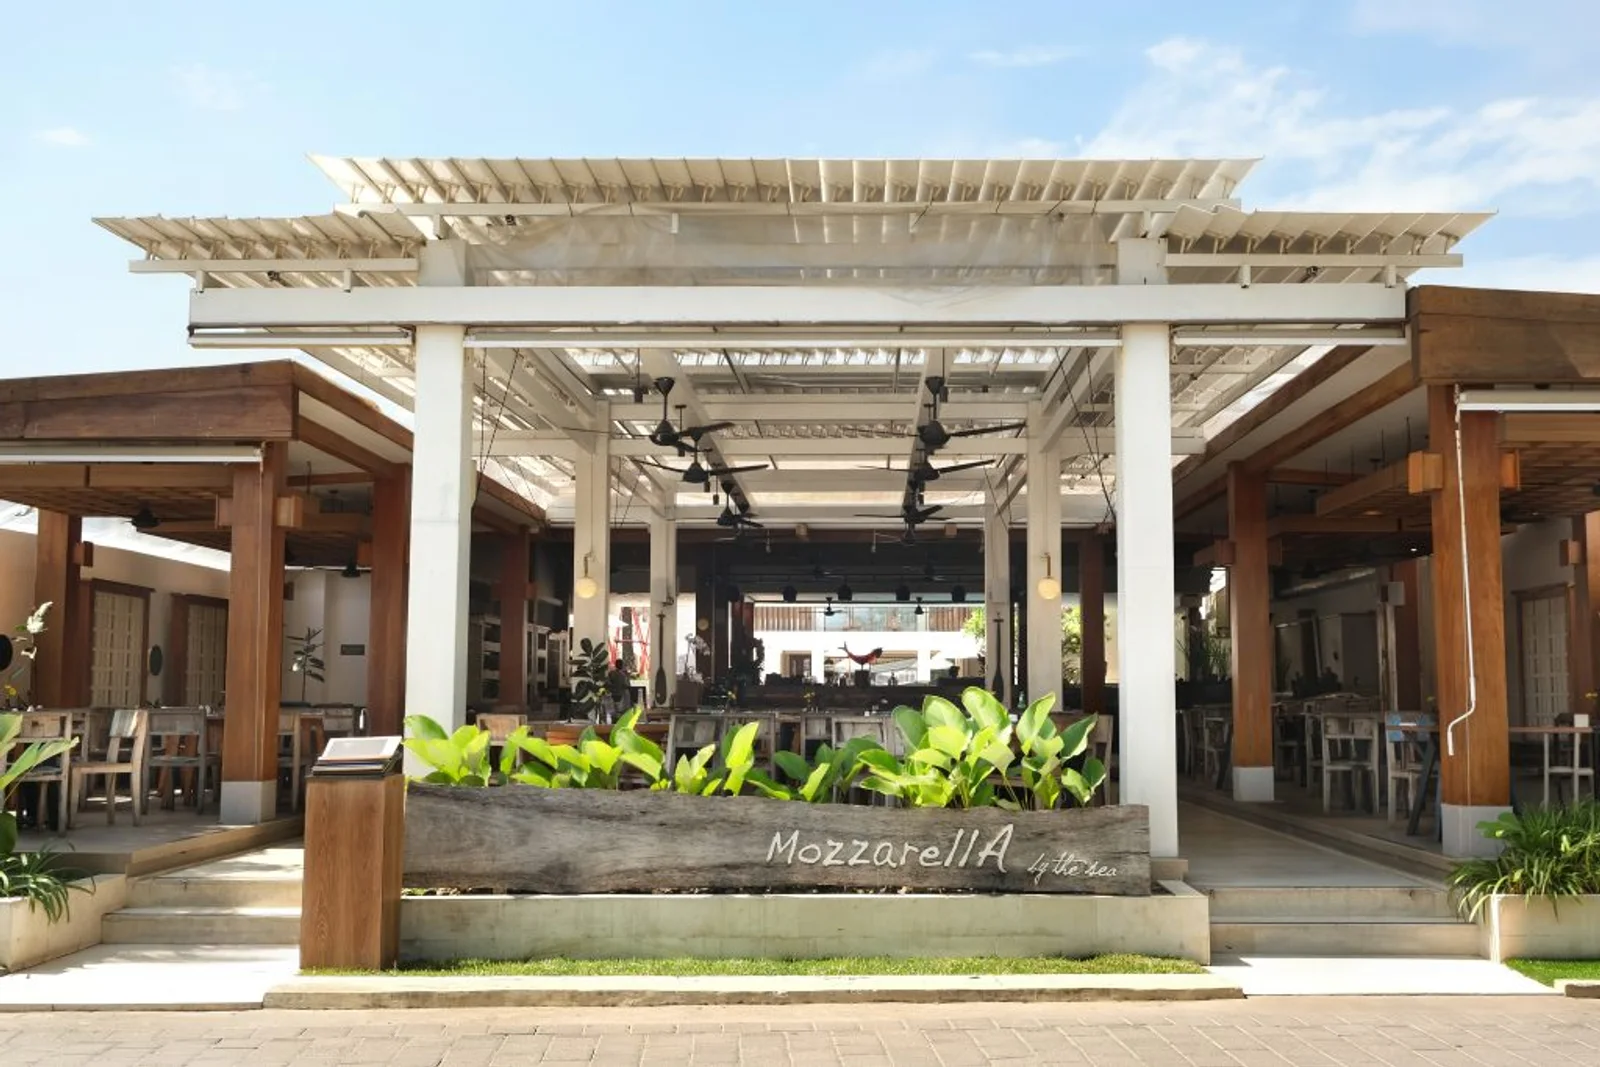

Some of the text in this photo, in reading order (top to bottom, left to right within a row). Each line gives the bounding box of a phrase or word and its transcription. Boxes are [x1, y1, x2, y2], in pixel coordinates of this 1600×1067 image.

[766, 823, 1117, 886] MozzarellA by the sea
